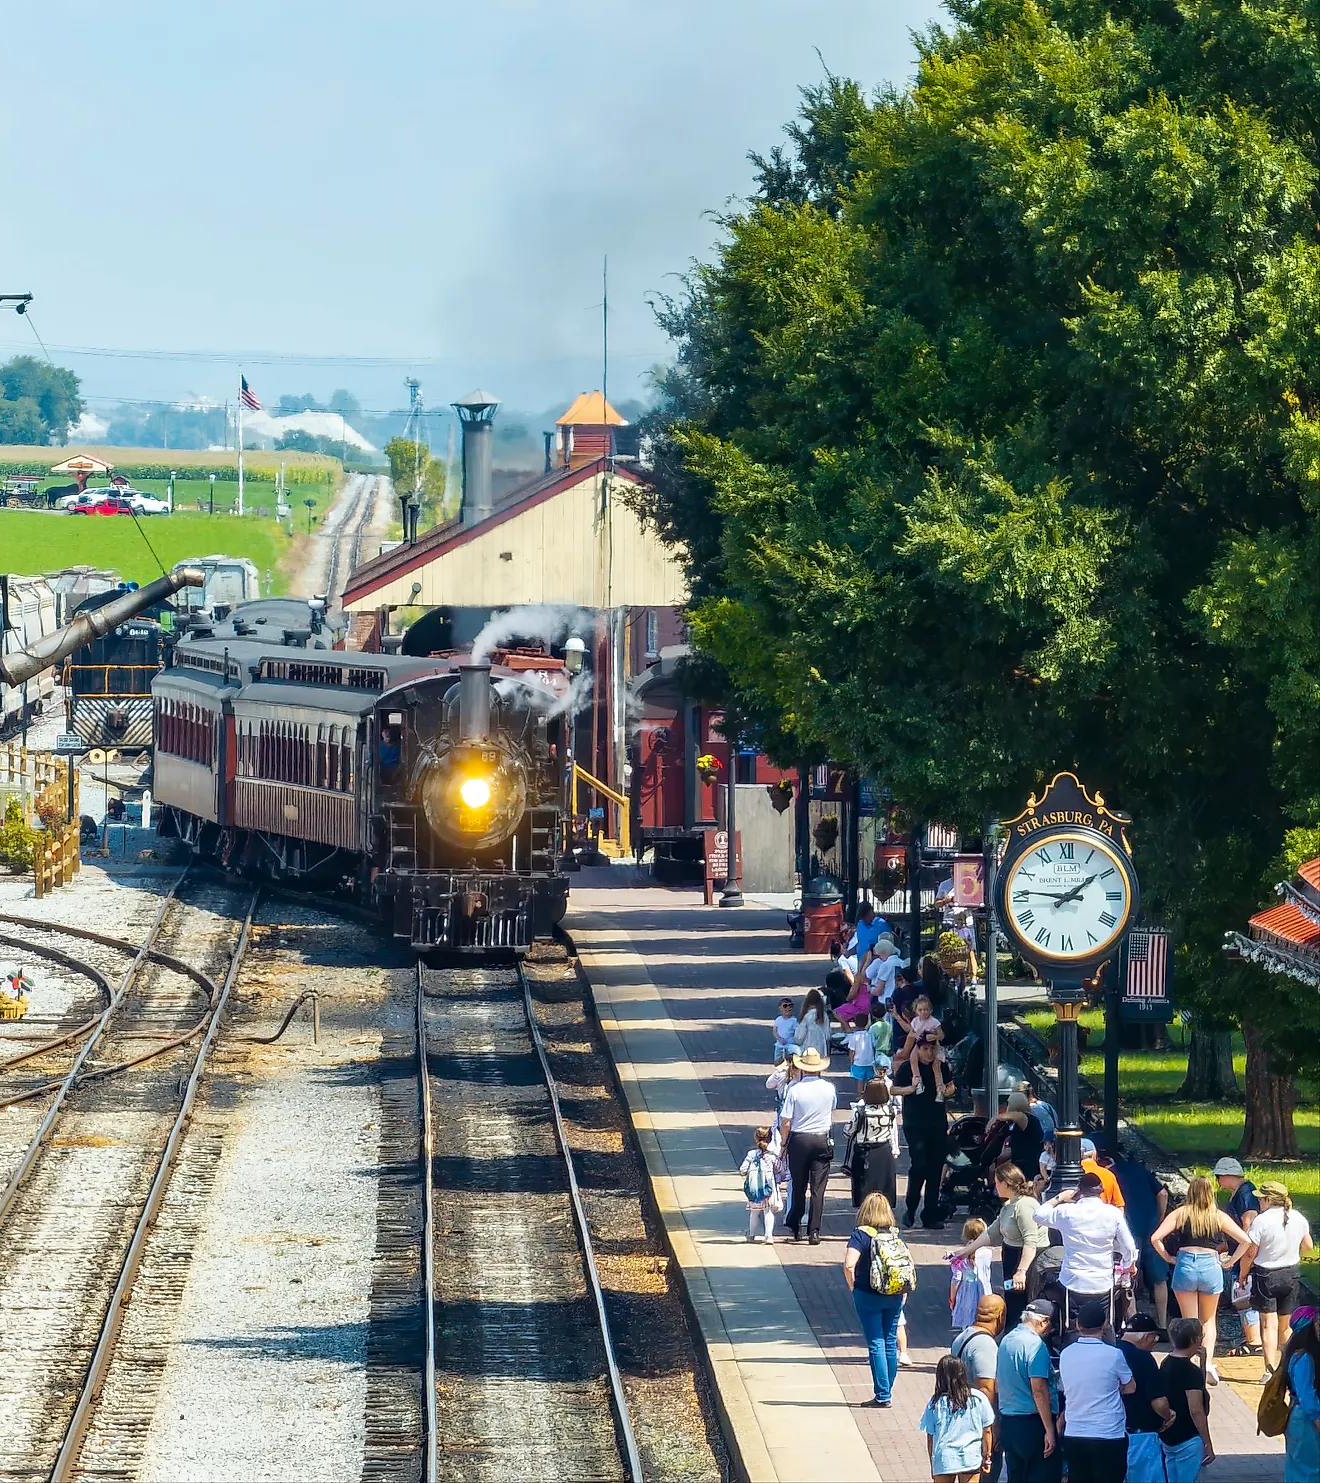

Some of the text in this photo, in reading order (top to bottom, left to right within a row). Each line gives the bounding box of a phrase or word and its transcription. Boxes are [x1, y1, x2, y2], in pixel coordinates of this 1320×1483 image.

[830, 770, 846, 793] 7
[1016, 811, 1113, 837] STRASBURG, PA
[1035, 847, 1053, 867] XI
[1060, 842, 1074, 860] XII
[959, 863, 981, 897] 5
